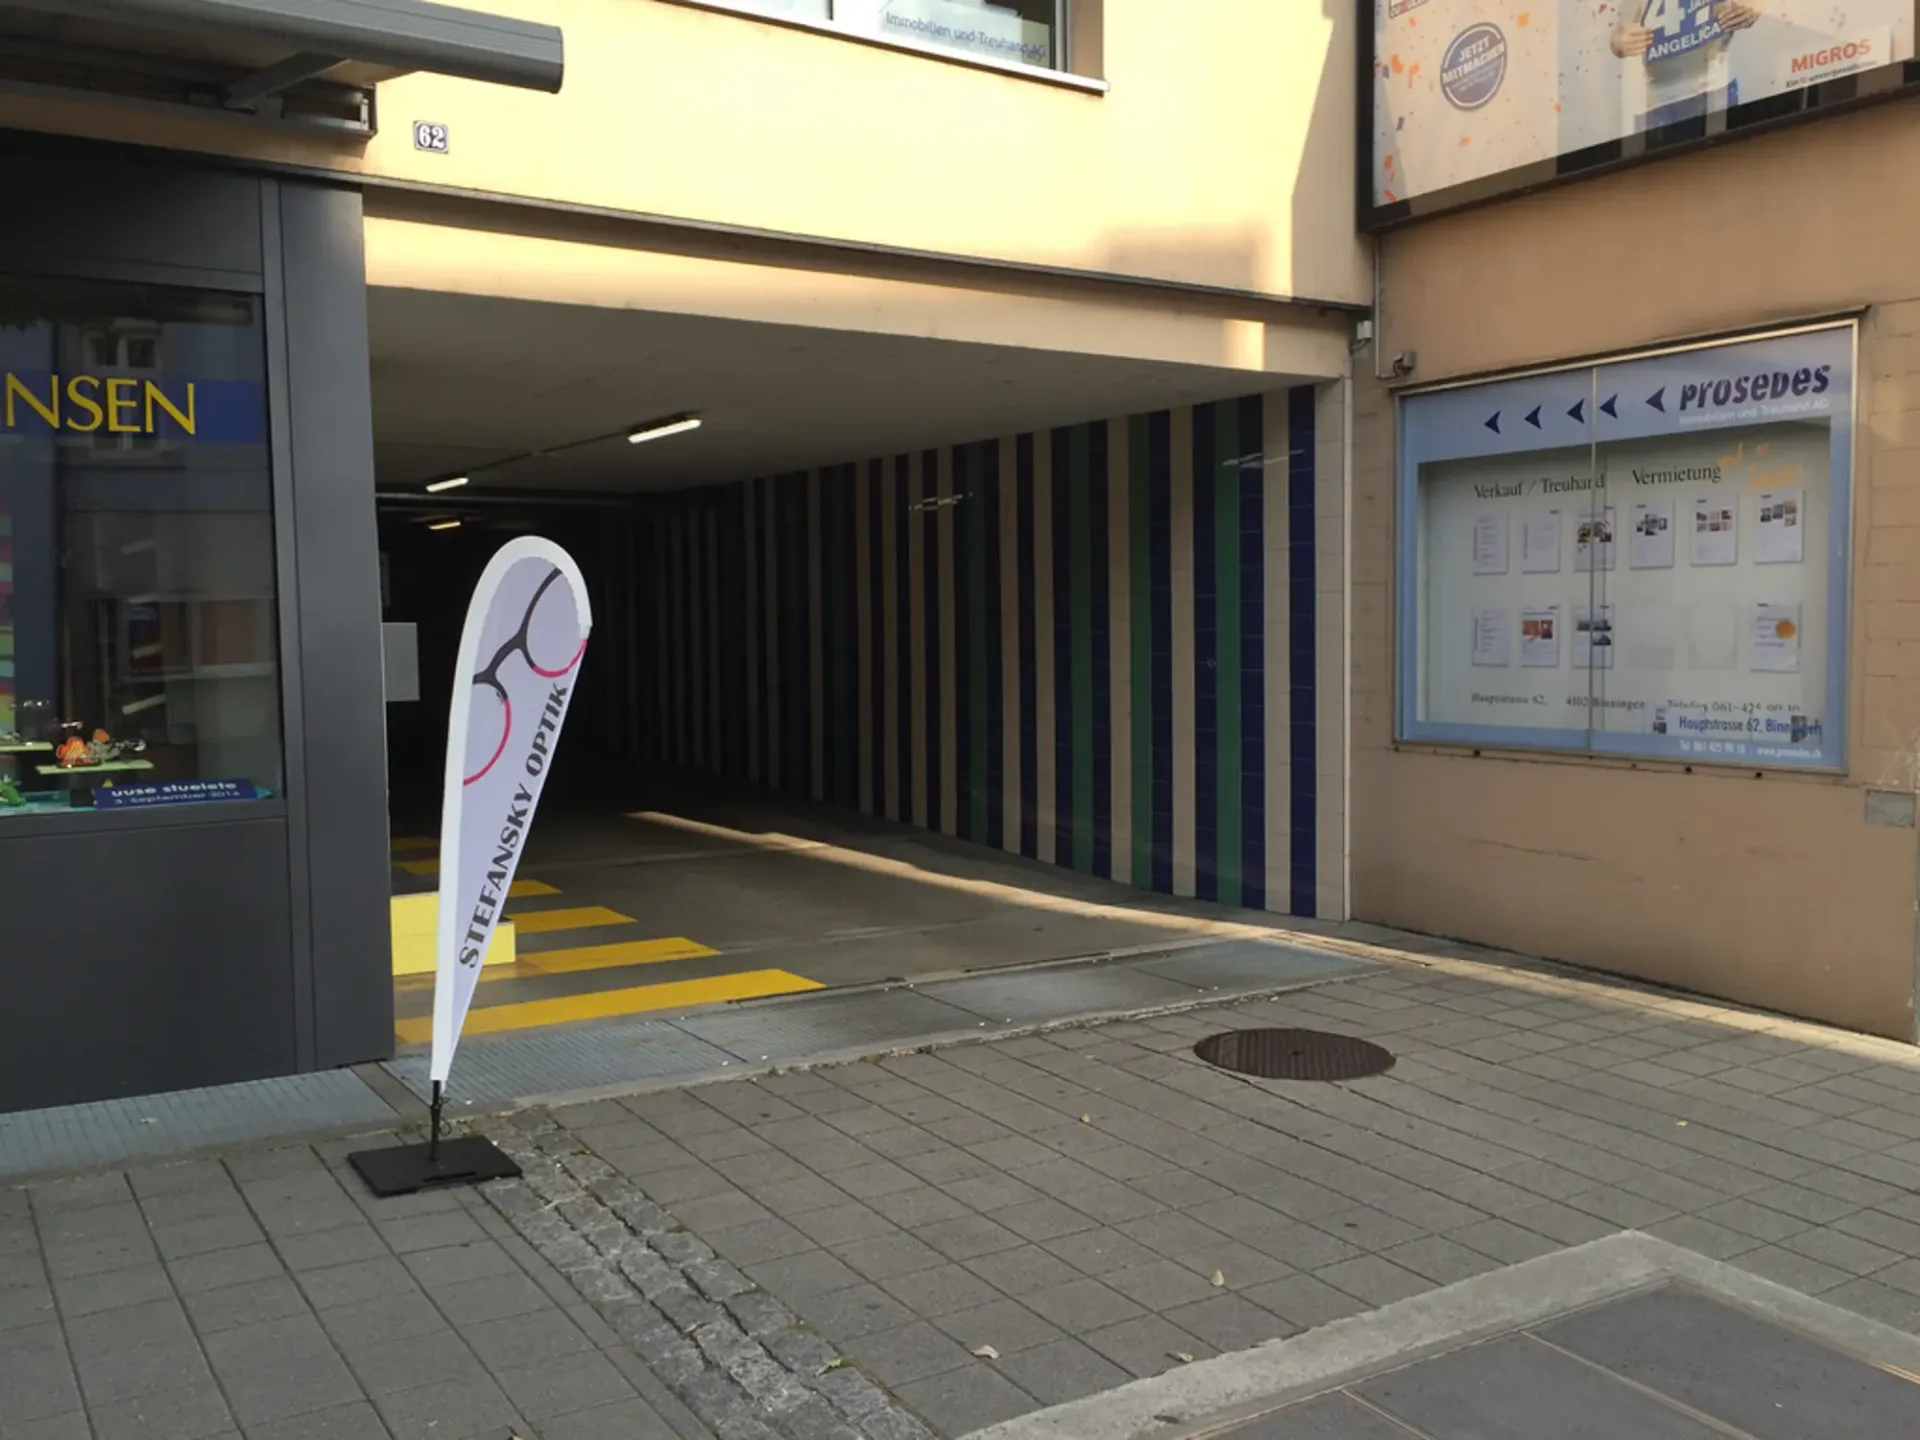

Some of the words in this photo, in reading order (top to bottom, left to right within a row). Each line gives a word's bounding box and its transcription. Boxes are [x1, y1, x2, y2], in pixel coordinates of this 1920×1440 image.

[886, 11, 951, 38] Immobilien
[954, 28, 976, 42] und
[1648, 21, 1721, 61] ANGELICA
[1442, 40, 1504, 83] MITMACHEN
[1458, 35, 1490, 62] JETZT
[1791, 38, 1872, 73] MIGROS
[420, 125, 445, 149] 62
[6, 372, 196, 436] NSEN
[1474, 479, 1525, 499] Verkauf
[1632, 465, 1721, 485] Vermietung
[1679, 716, 1744, 734] Hauptstrasse
[1746, 717, 1763, 733] 62,
[459, 783, 534, 969] STEFANSKY
[525, 681, 568, 778] OPTIK
